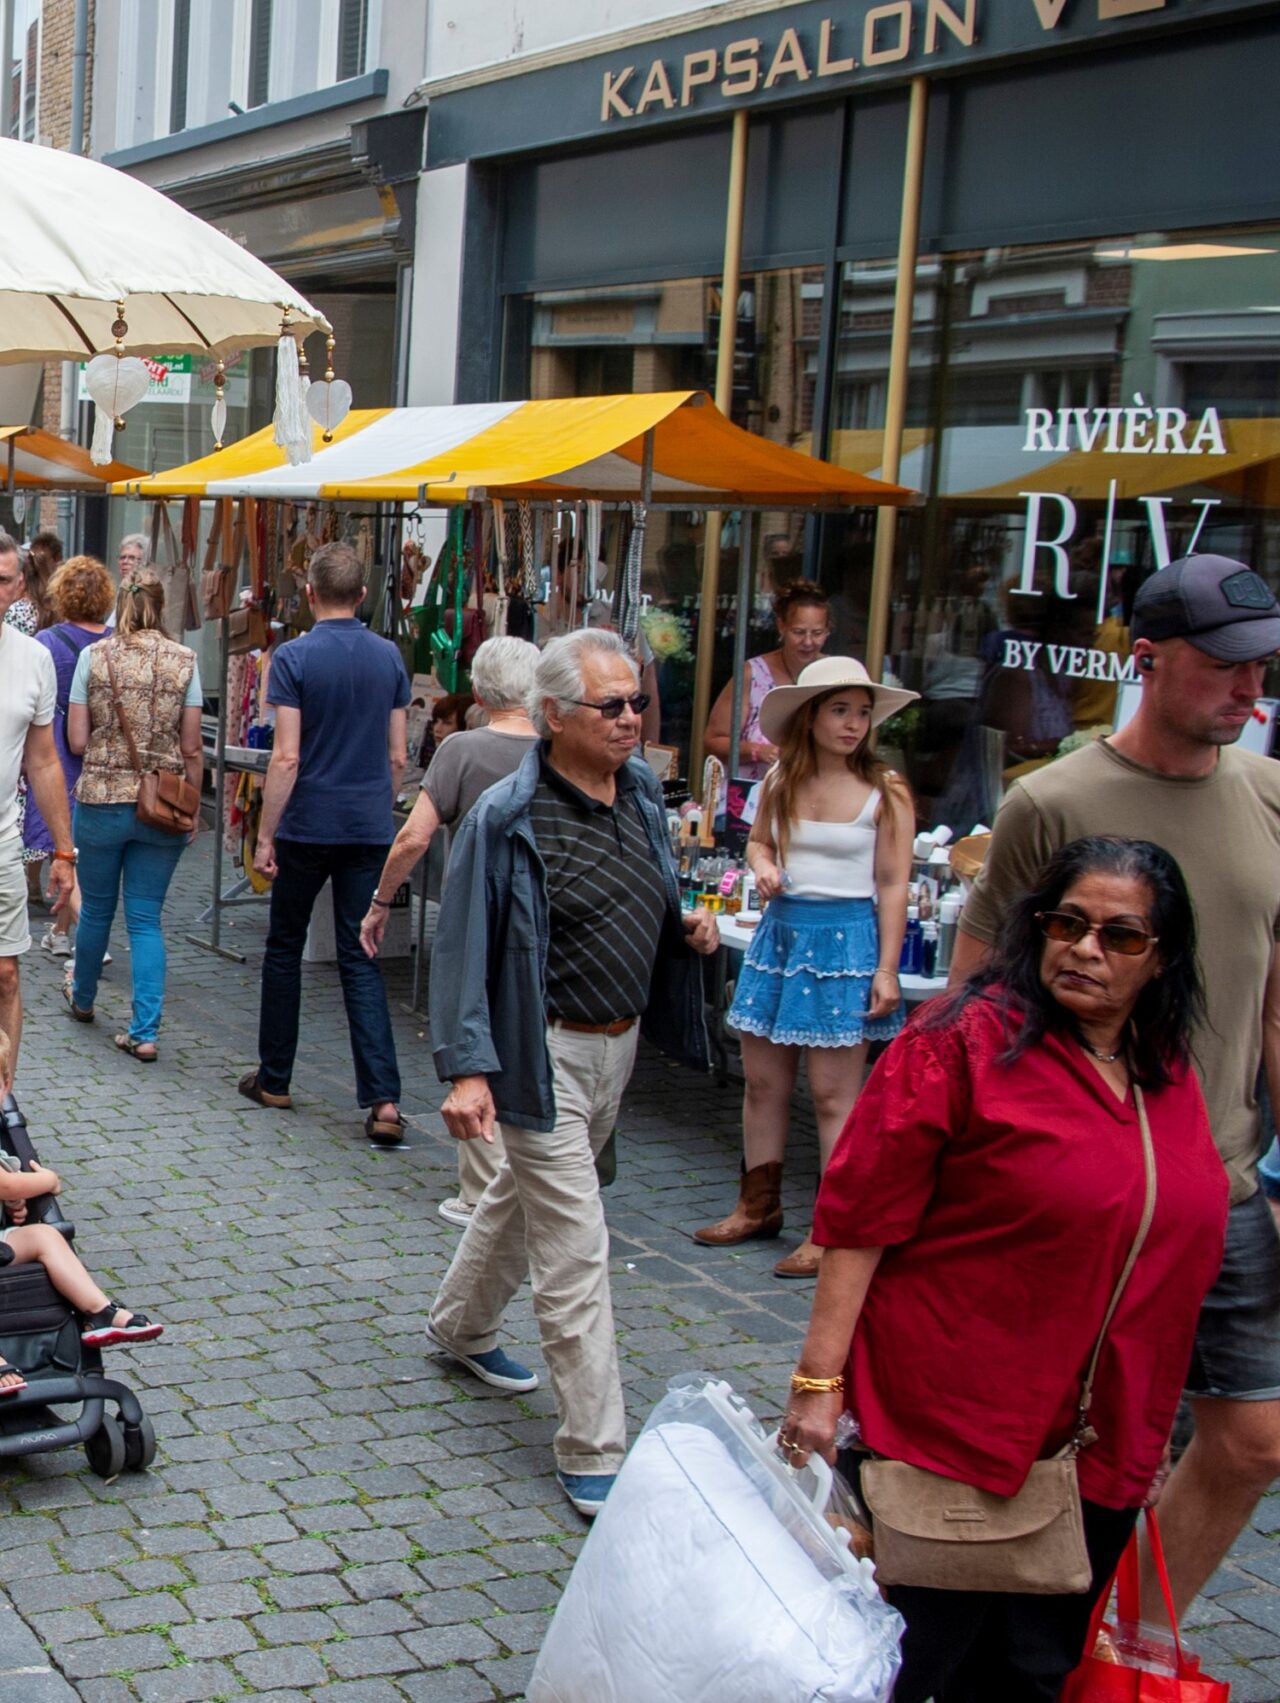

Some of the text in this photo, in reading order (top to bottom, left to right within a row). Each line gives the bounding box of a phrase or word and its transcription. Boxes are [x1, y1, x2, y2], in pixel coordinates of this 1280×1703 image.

[600, 0, 974, 121] KAPSALON
[1021, 392, 1227, 455] RIVIÈRA
[1002, 639, 1042, 671] BY
